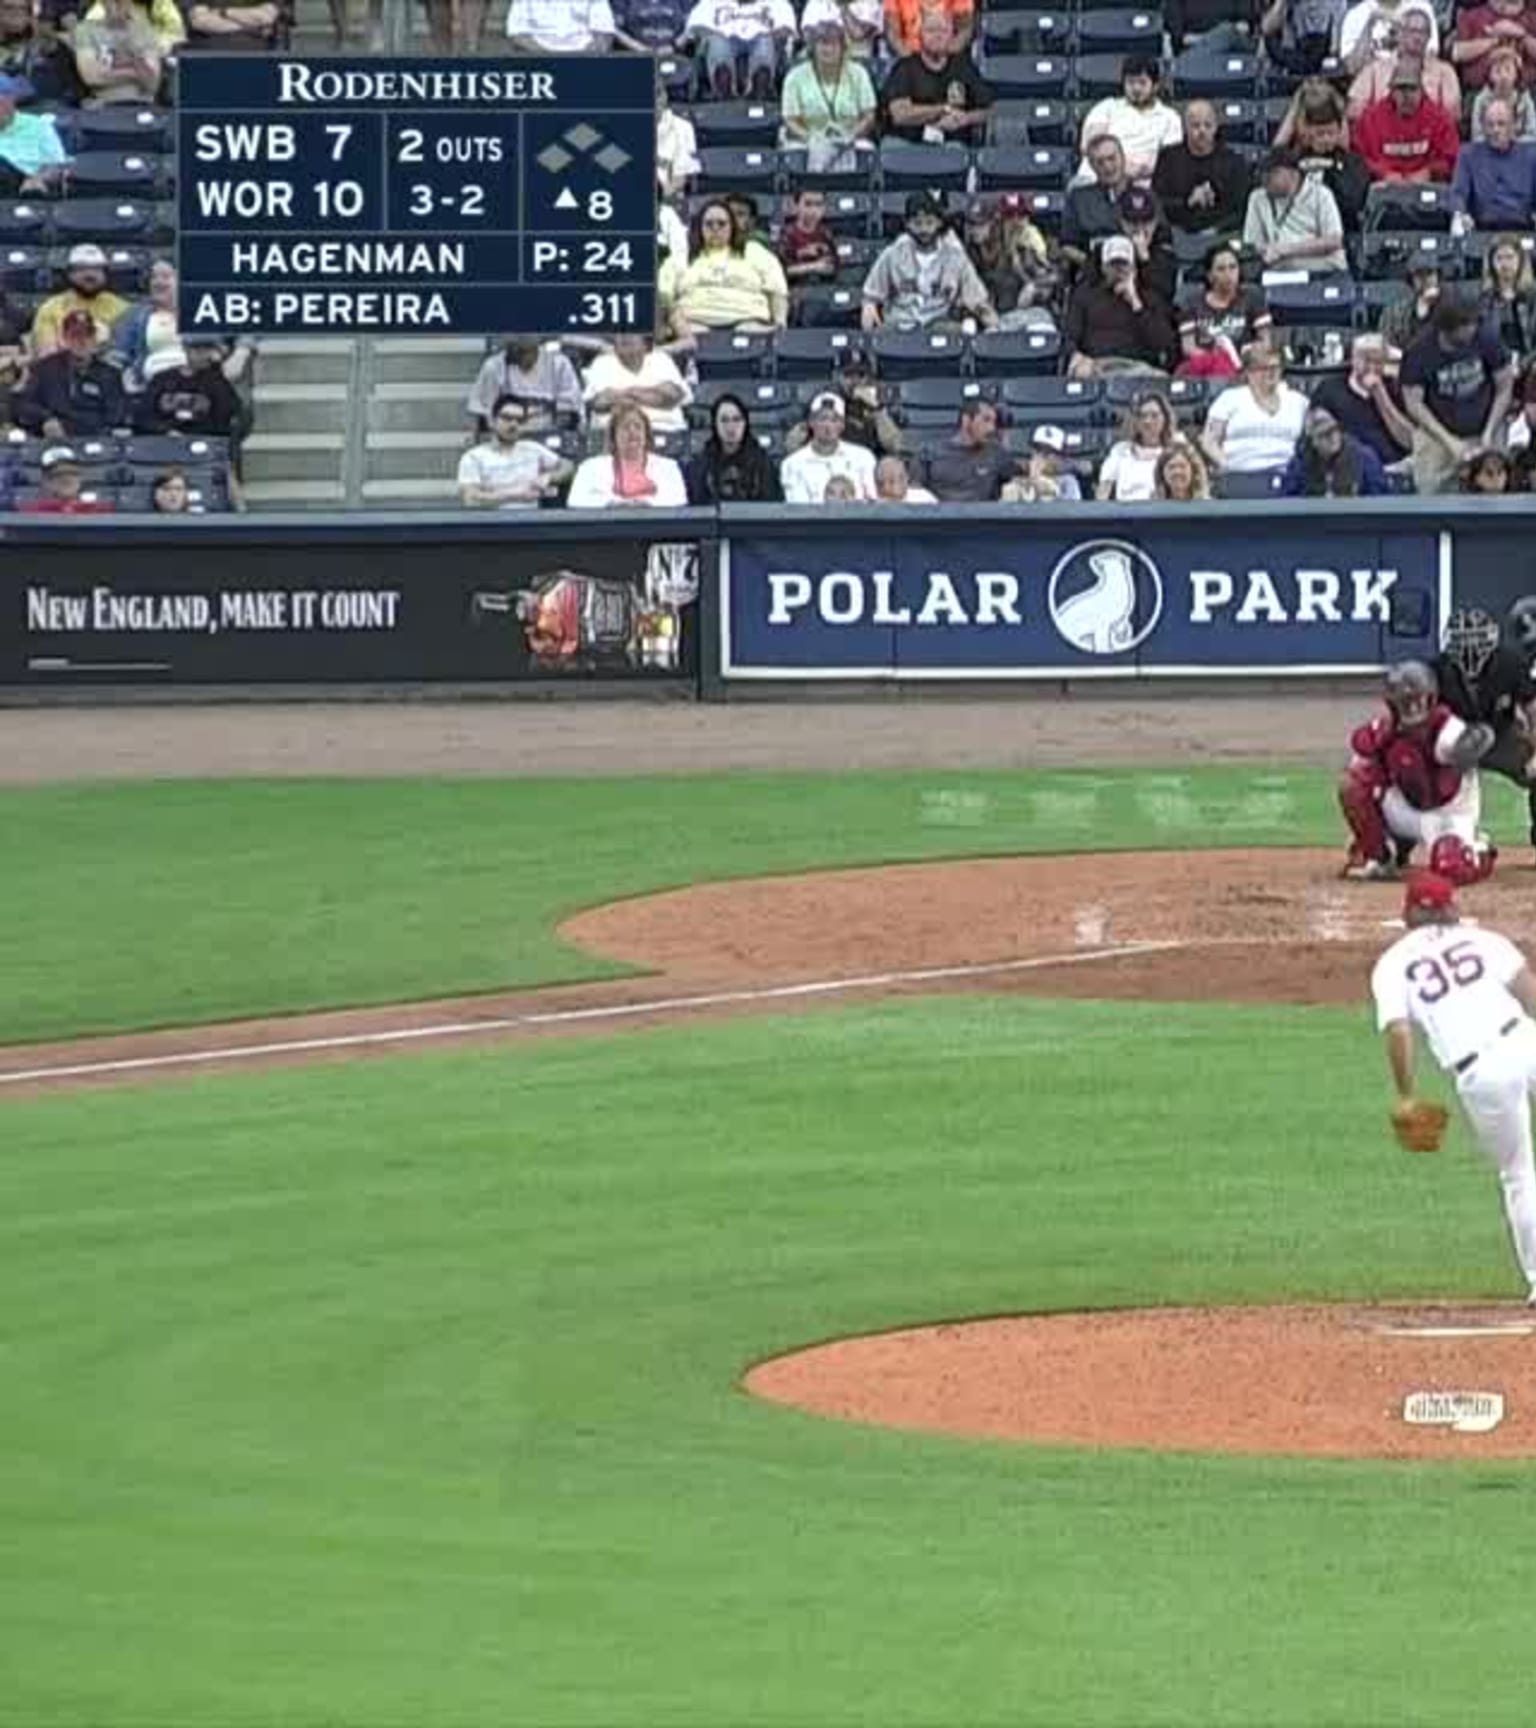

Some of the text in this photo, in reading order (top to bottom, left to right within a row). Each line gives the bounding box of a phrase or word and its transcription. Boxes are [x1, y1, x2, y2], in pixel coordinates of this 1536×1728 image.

[28, 588, 87, 631] NEW
[221, 592, 287, 628] MAKE
[292, 591, 318, 628] IT
[321, 591, 399, 628] COUNT
[768, 569, 1398, 624] POLAR PARK
[1405, 941, 1484, 1003] 35
